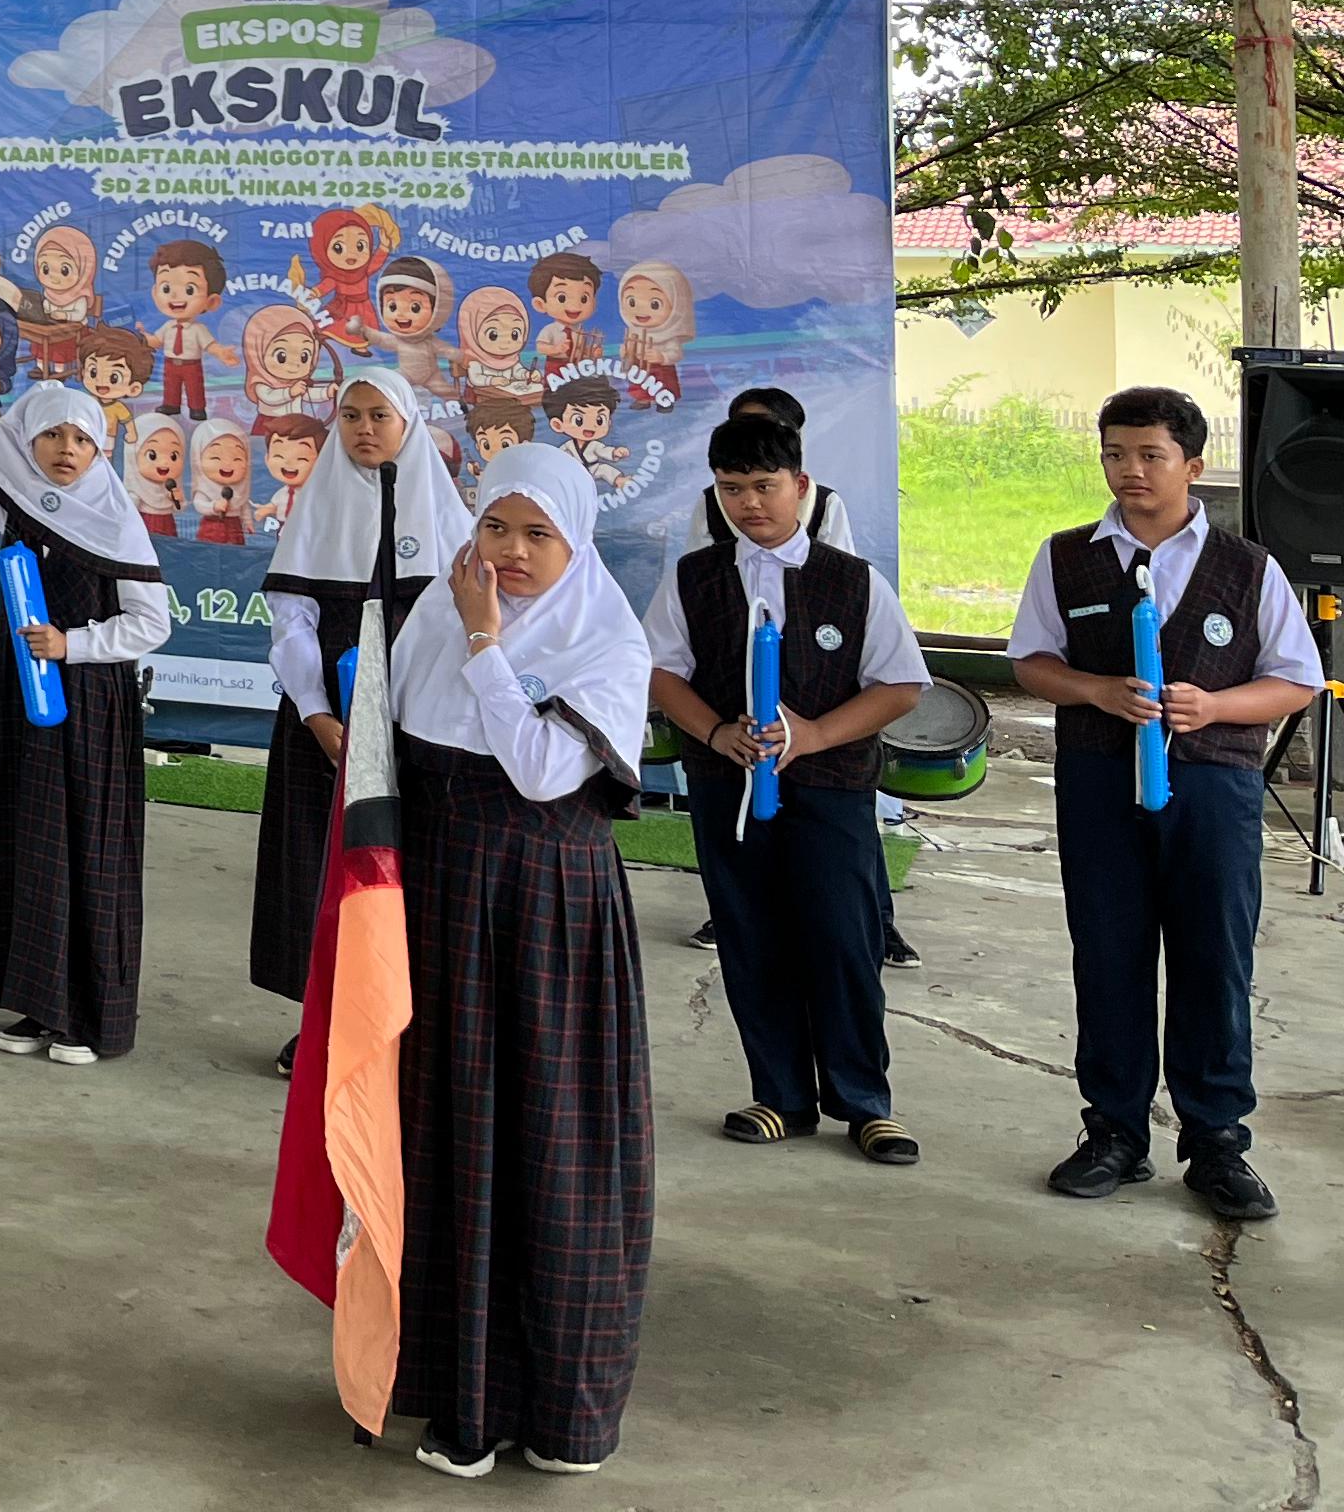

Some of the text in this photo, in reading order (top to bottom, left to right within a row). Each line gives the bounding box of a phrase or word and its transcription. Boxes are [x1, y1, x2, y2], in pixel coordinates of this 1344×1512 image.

[196, 18, 363, 50] EKSPOSE
[119, 66, 442, 142] EKSKUL
[59, 146, 230, 166] PENDAFTARAN
[235, 148, 353, 167] ANGGOTA
[358, 149, 427, 168] BARU
[431, 150, 685, 171] EKSTRAKURIKULER
[101, 178, 466, 199] SD 2 DARUL HIKAM 2025-2026
[12, 201, 72, 264] CODING
[103, 209, 228, 272] FUN ENGLISH
[259, 220, 314, 239] TARI
[417, 221, 588, 263] MENGGAMBAR
[226, 273, 334, 328] MEMANAH
[546, 358, 676, 408] ANGKLUNG
[598, 439, 665, 512] KWONDO
[197, 589, 238, 624] 12
[154, 671, 254, 690] arulhikam_sd2
